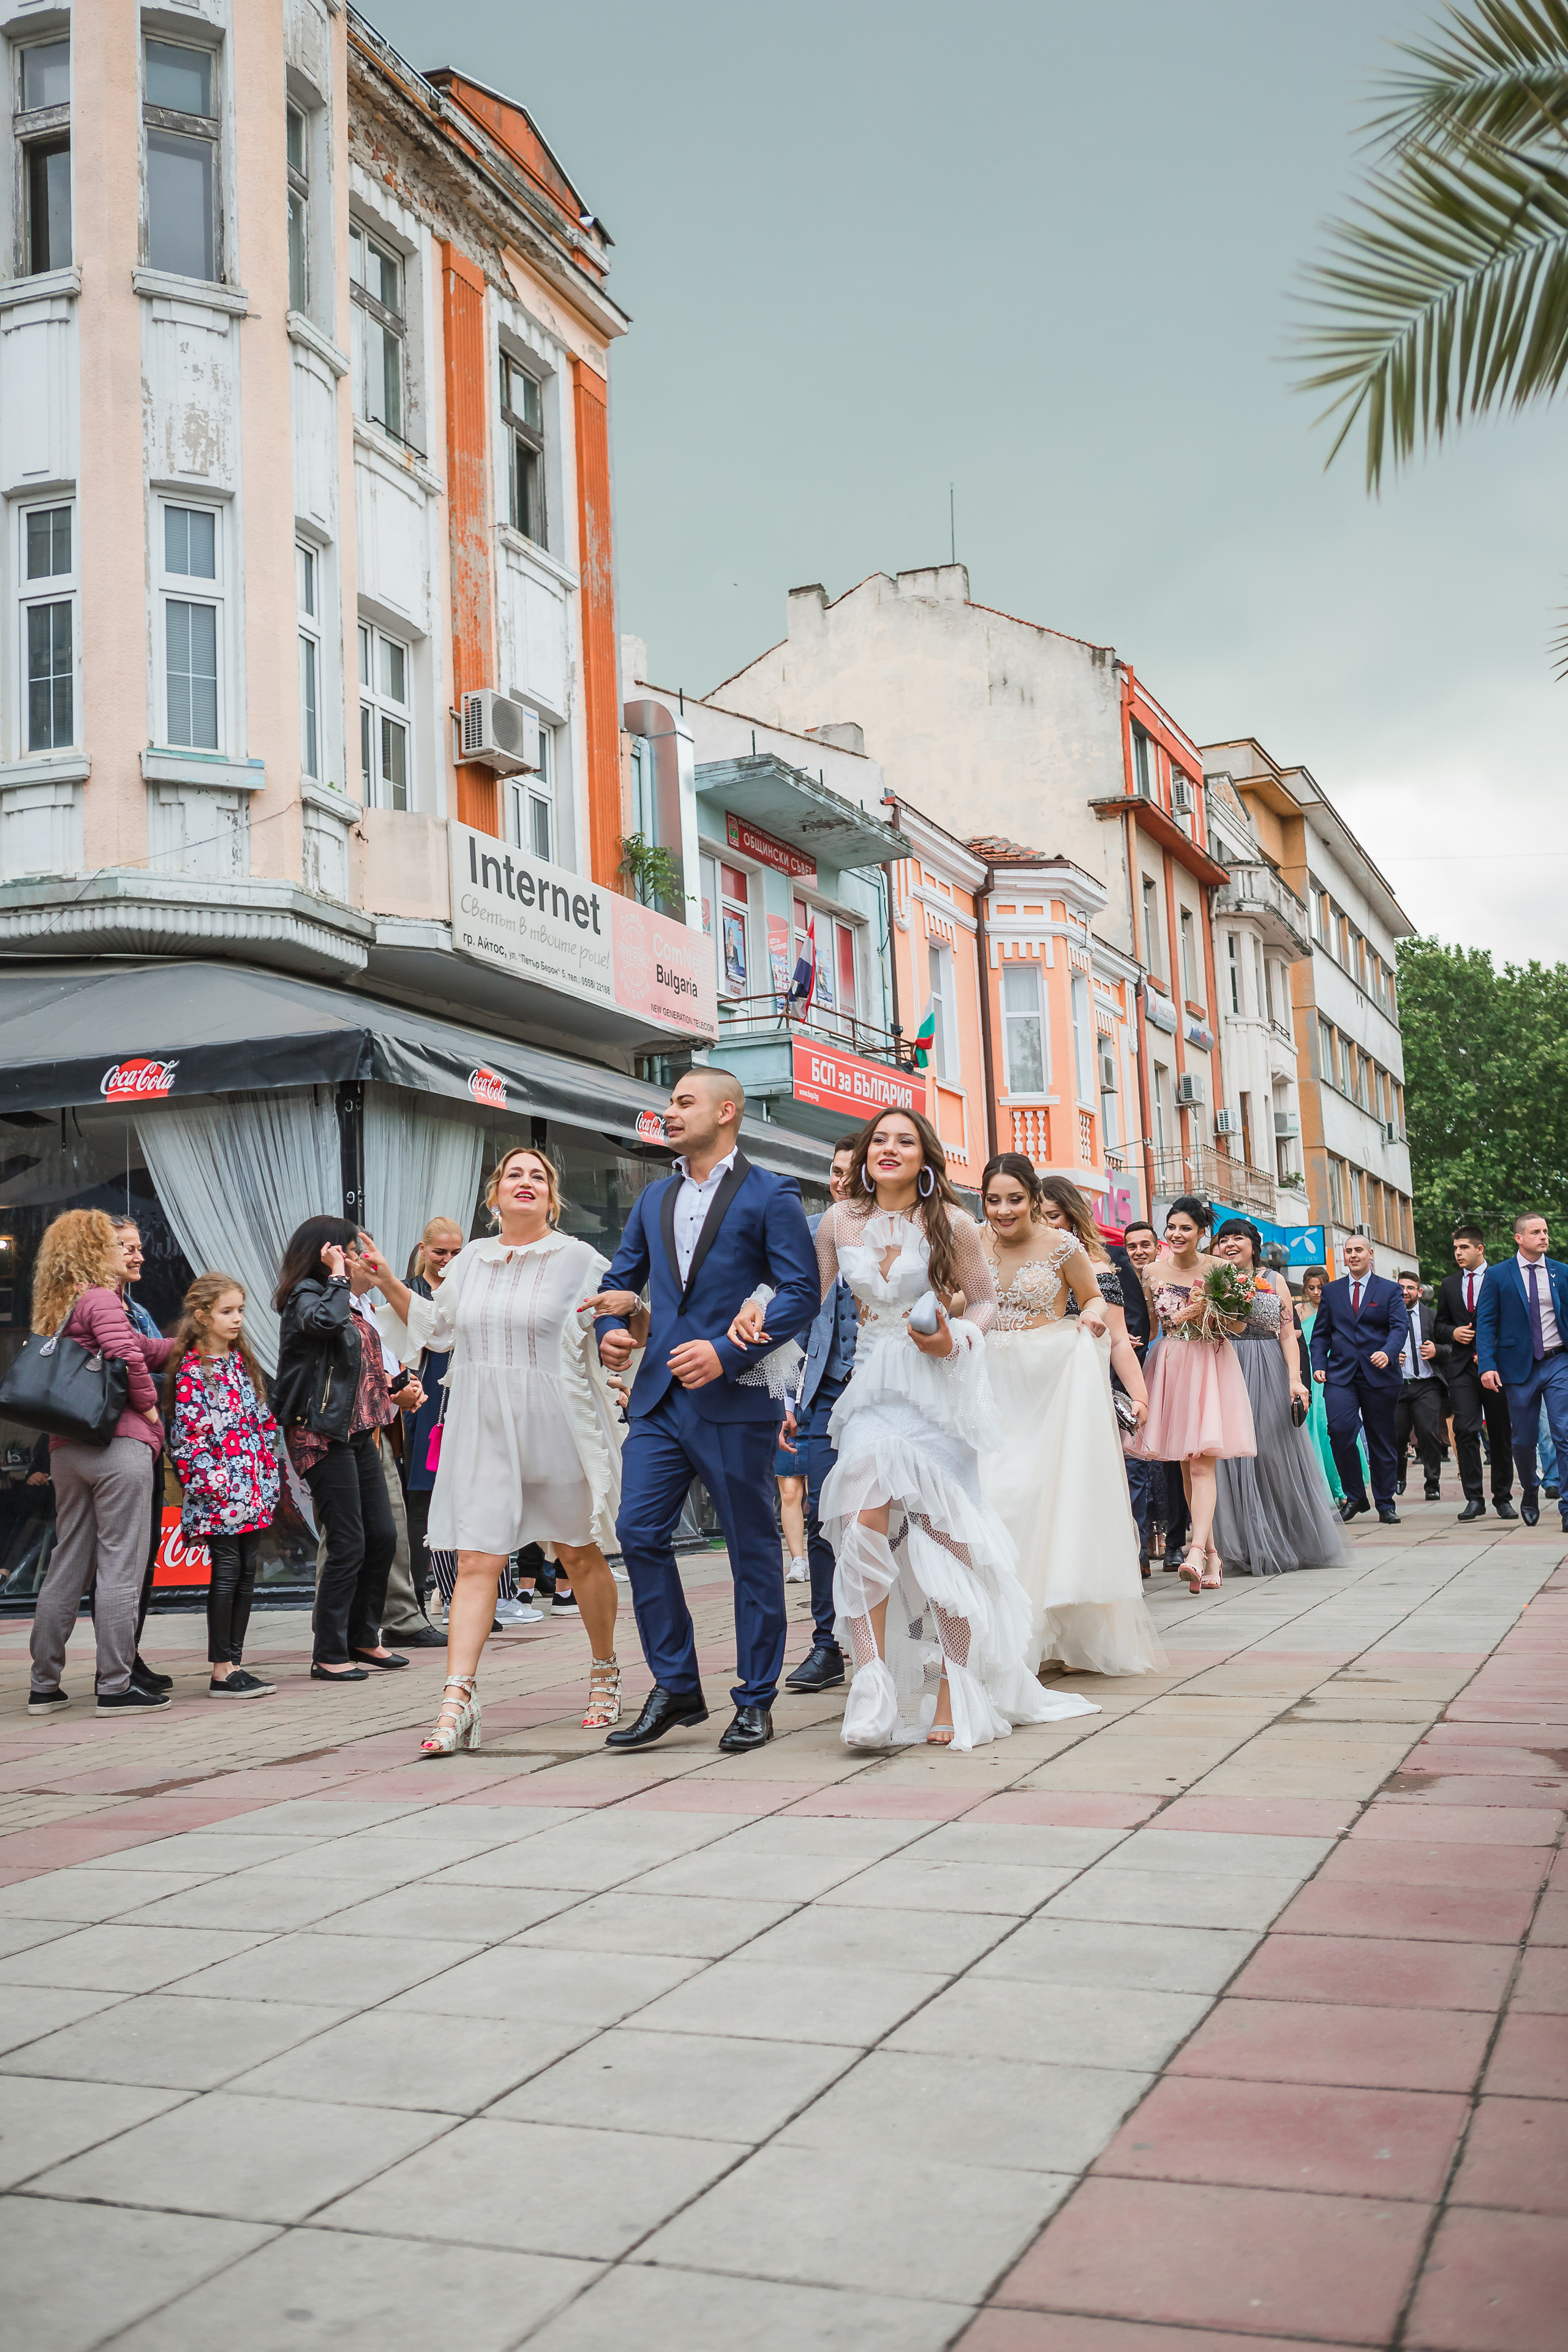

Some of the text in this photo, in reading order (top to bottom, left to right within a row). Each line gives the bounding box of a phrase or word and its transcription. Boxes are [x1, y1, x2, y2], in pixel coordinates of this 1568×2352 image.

[743, 832, 812, 877] ОБЩИНСКИ СЪВЕТ
[469, 835, 601, 935] Internet
[463, 932, 475, 947] гр.
[477, 935, 507, 959] Айтос,
[508, 951, 518, 960] ул.
[581, 976, 595, 989] 0558/
[596, 981, 611, 995] 22188
[530, 925, 577, 955] твоите
[579, 945, 610, 969] ръце!
[618, 944, 651, 967] INTERNET
[653, 933, 704, 976] ComNet
[619, 971, 650, 1000] BULGARIA
[656, 963, 698, 998] Bulgaria
[650, 1003, 714, 1033] NEW GENERATION TELECOM
[100, 1059, 181, 1095] Coca-Cola
[467, 1069, 508, 1102] Coca-Cola
[811, 1057, 913, 1109] БСП за БЪЛГАРИЯ
[635, 1111, 666, 1140] Coca-Cola
